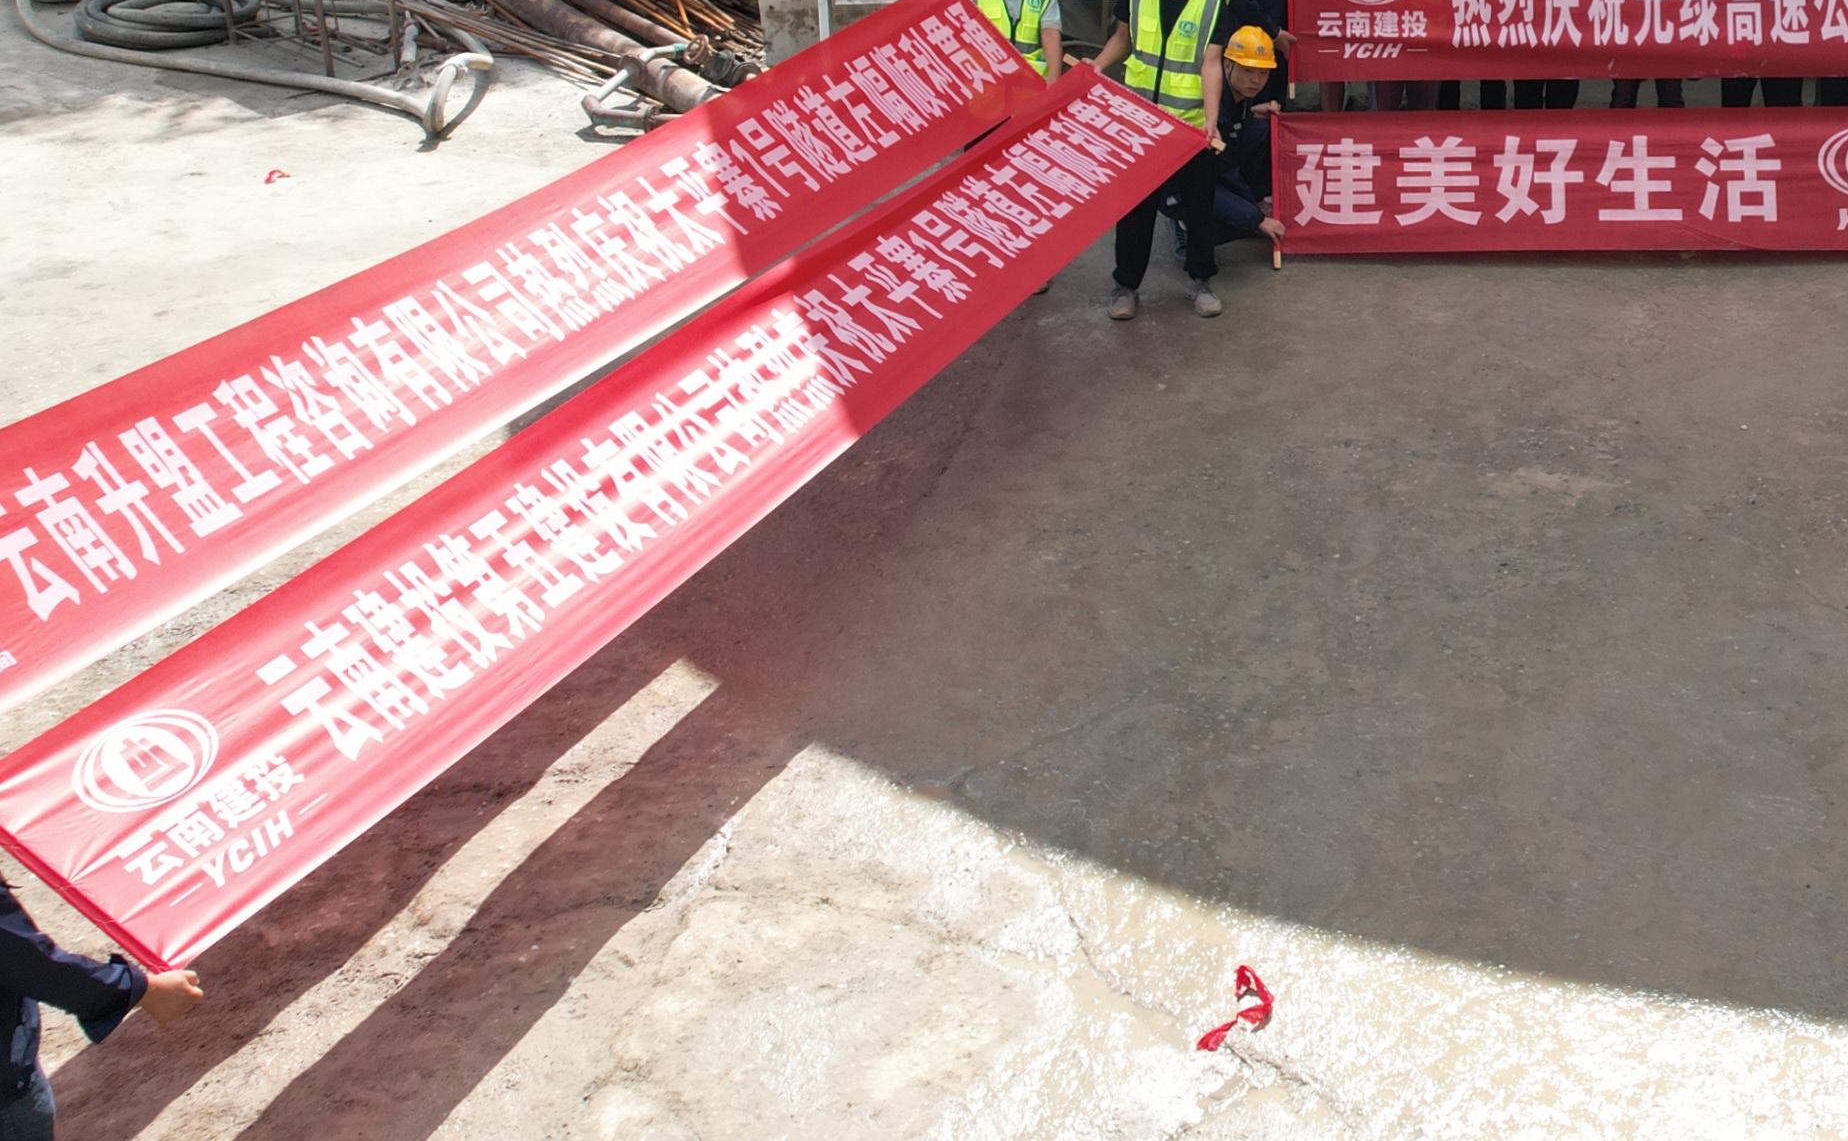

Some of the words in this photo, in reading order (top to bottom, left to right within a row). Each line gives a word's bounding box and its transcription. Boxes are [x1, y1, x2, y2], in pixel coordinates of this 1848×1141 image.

[1317, 10, 1427, 38] 云南建投
[1342, 43, 1402, 59] YCIH
[1295, 134, 1782, 226] 建美好生活
[0, 2, 1019, 621] 云南升盟工程咨询有限公司热烈庆祝太平寨1号隧道左幅顺利贯通
[256, 83, 1175, 762] 云南建投第五建设有限公司热烈庆祝太平寨1号隧道左幅顺利贯通
[118, 751, 304, 886] 云南建投
[200, 807, 294, 888] YCIH
